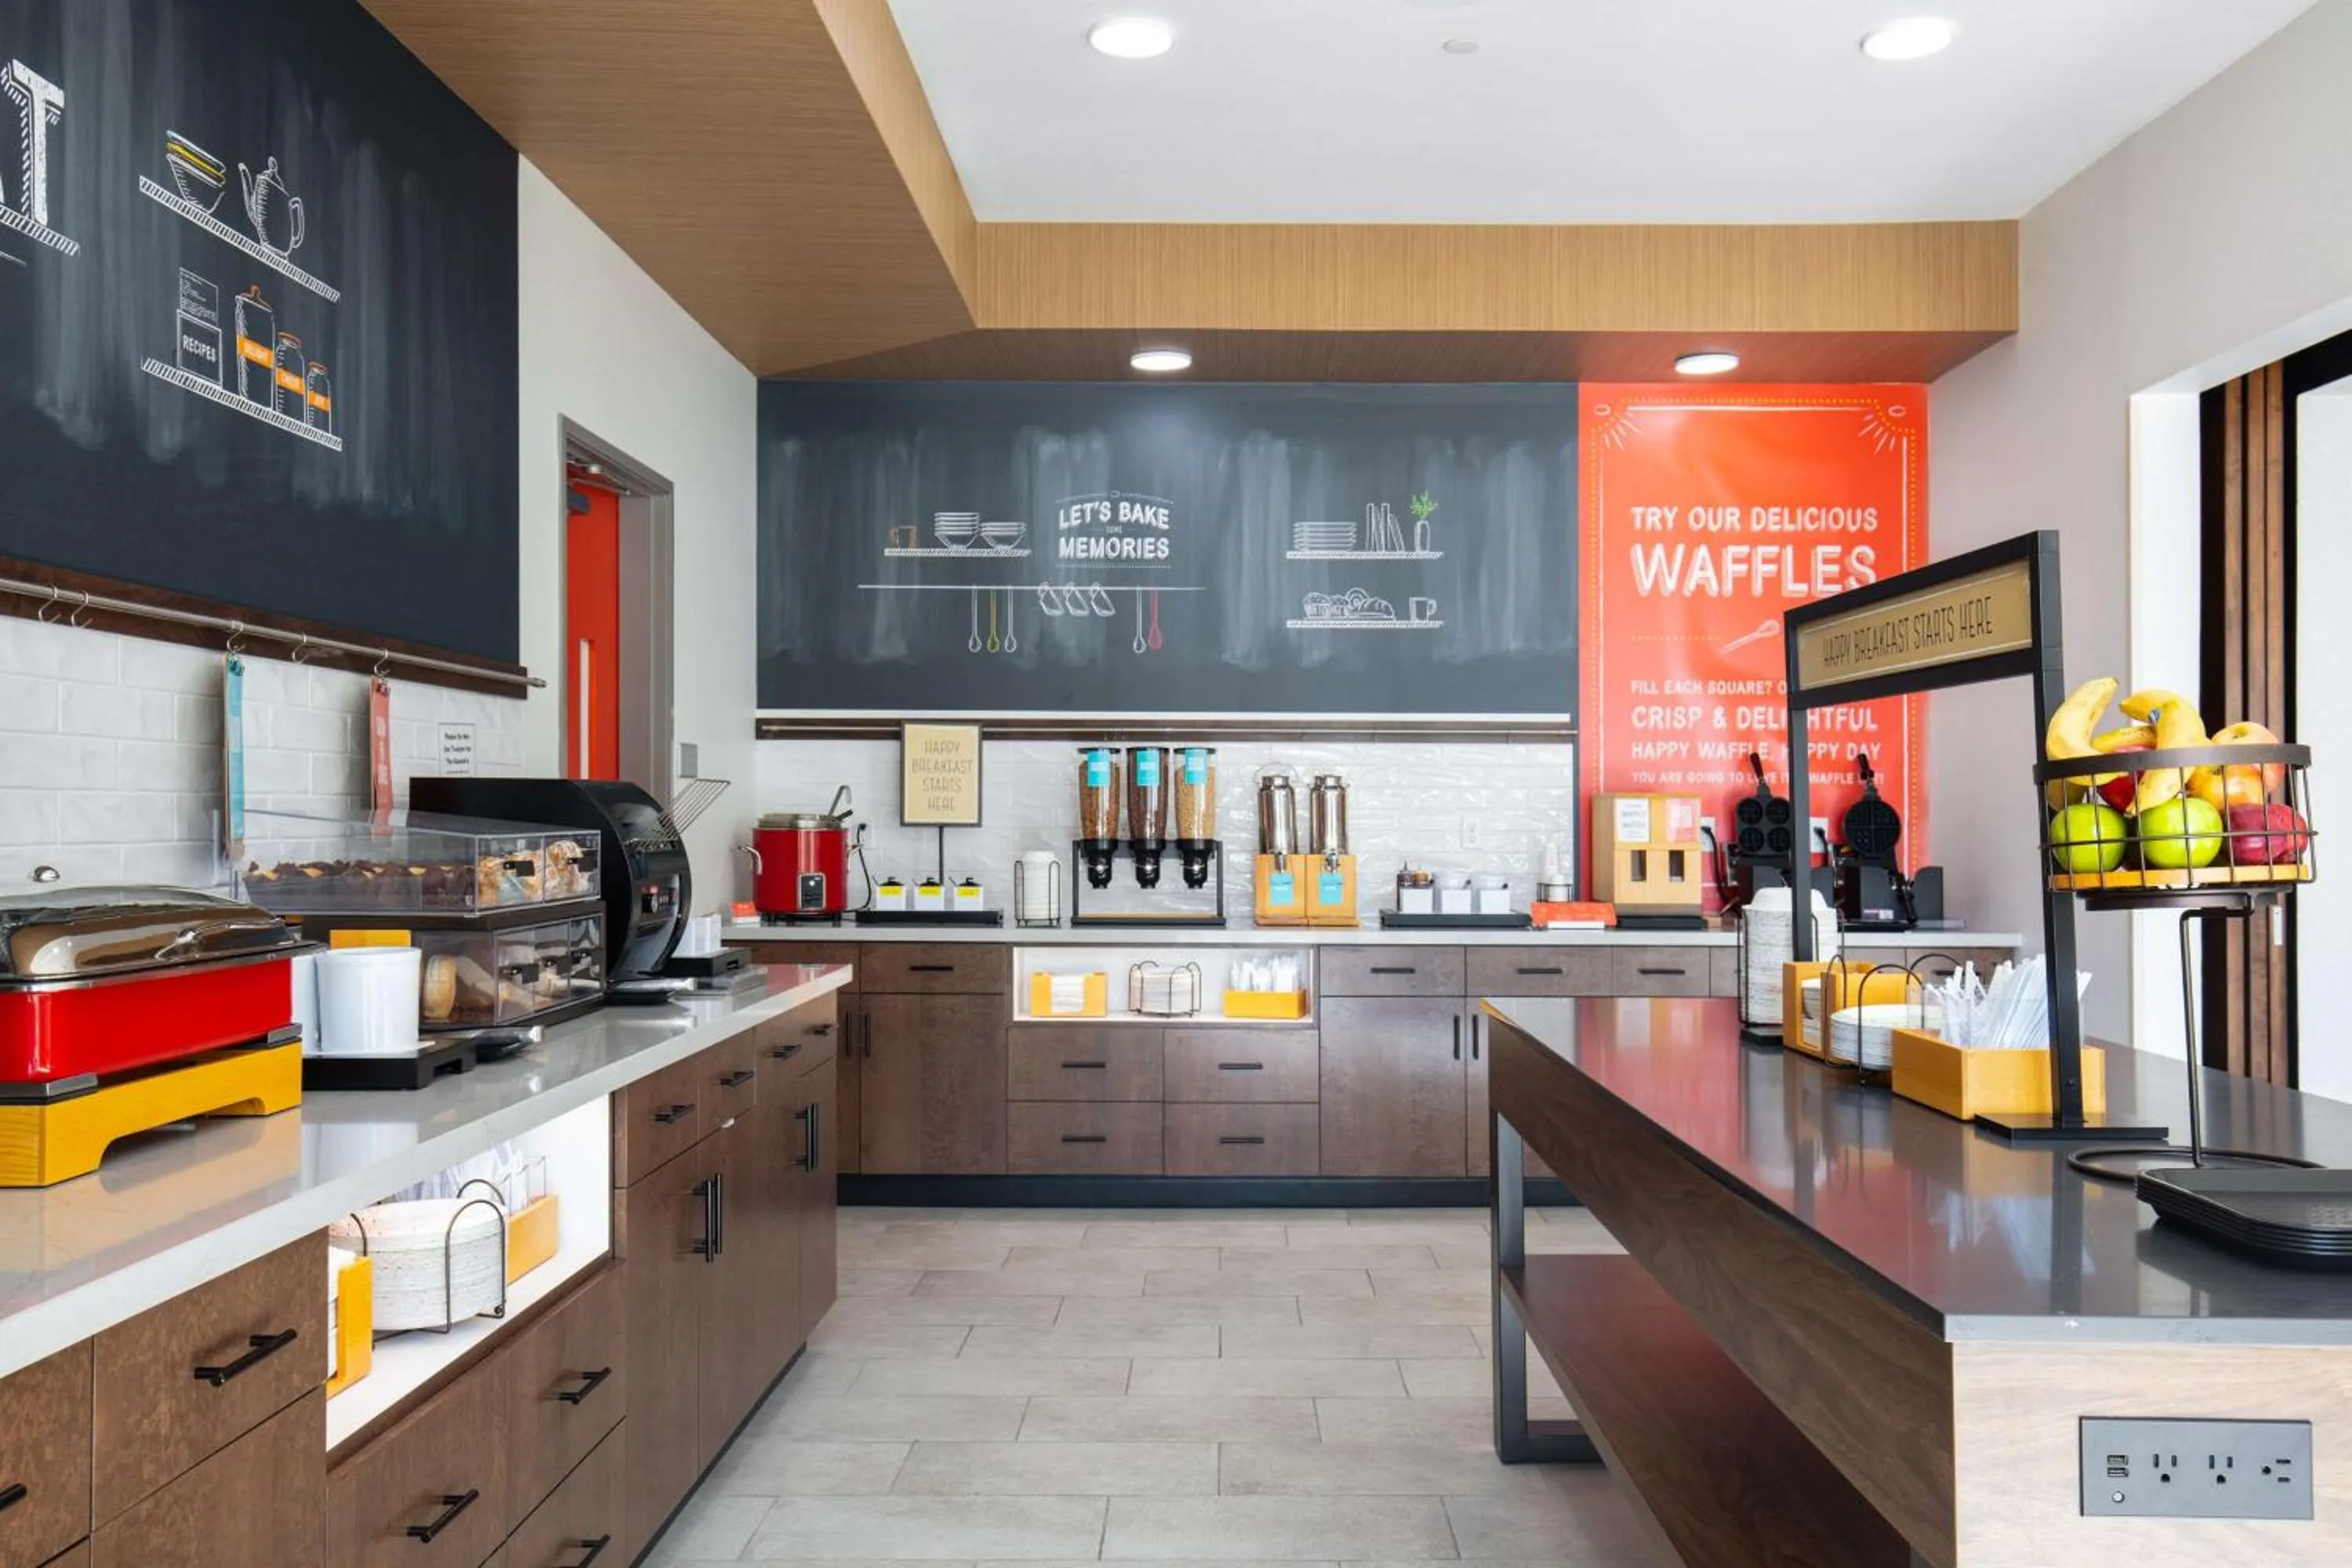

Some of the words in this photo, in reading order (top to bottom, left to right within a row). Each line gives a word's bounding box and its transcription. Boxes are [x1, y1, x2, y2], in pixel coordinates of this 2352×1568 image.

[182, 334, 216, 362] RECIPES
[1059, 501, 1111, 530] LET'S
[1119, 501, 1170, 530] BAKE
[1631, 506, 1678, 531] TRY
[1688, 506, 1741, 532] OUR
[1750, 506, 1878, 532] DELICIOUS
[1059, 536, 1170, 560] MEMORIES
[1630, 543, 1877, 597] WAFFLES
[1823, 633, 1852, 666] HAPPY
[1854, 618, 1910, 662] BREAKFAST
[1914, 606, 1955, 649] STARTS
[1959, 596, 1992, 640] HERE
[1631, 680, 1659, 695] FILL
[1664, 680, 1702, 695] EACH
[1707, 680, 1772, 695] SQUARE?
[1632, 706, 1703, 730] CRISP
[1711, 706, 1727, 729] &
[1736, 706, 1878, 731] DELIHTFUL
[924, 739, 960, 753] HAPPY
[1632, 741, 1690, 760] HAPPY
[1846, 742, 1882, 761] DAY
[911, 757, 973, 774] BREAKFAST
[923, 777, 962, 793] STARTS
[1632, 771, 1655, 783] YOU
[1658, 771, 1682, 783] ARE
[1686, 771, 1724, 783] GOING
[1730, 771, 1744, 783] TO
[1809, 772, 1853, 785] WAFFLE
[928, 796, 955, 811] HERE
